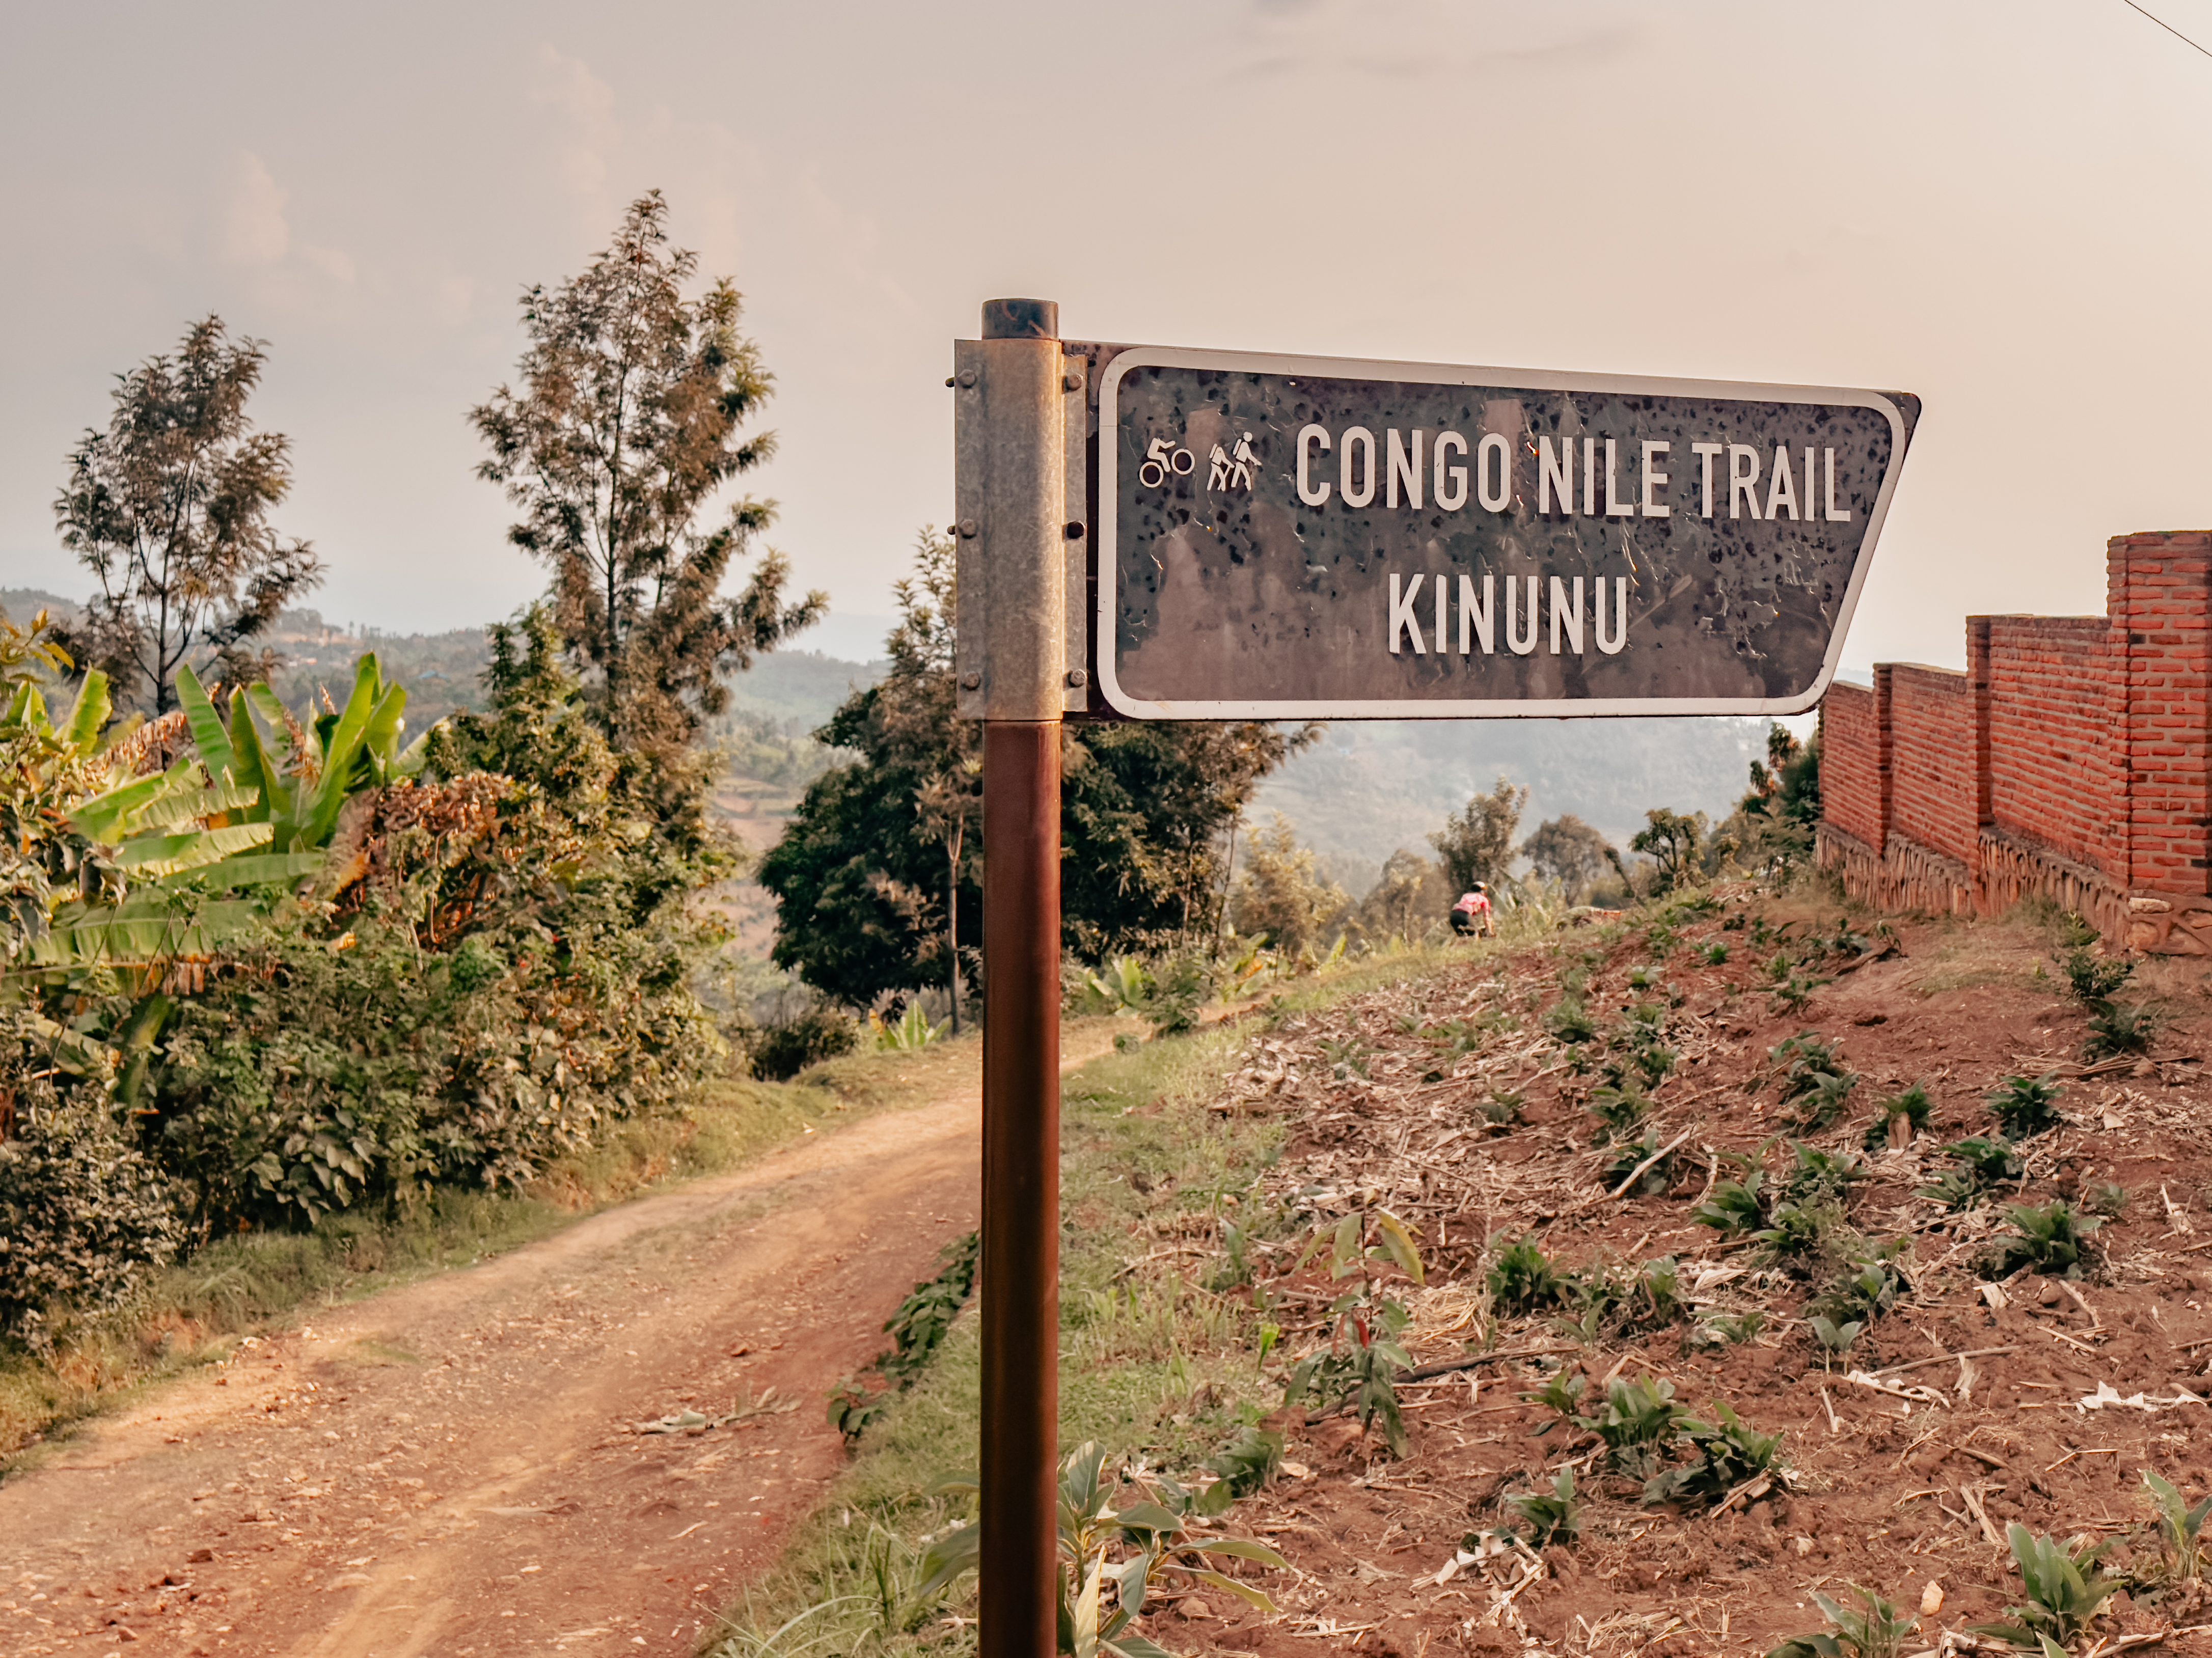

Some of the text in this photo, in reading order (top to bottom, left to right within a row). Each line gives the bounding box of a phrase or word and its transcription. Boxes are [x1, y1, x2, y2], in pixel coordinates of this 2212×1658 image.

[1297, 424, 1851, 521] CONGO NILE TRAIL
[1389, 573, 1626, 655] KINUNU
